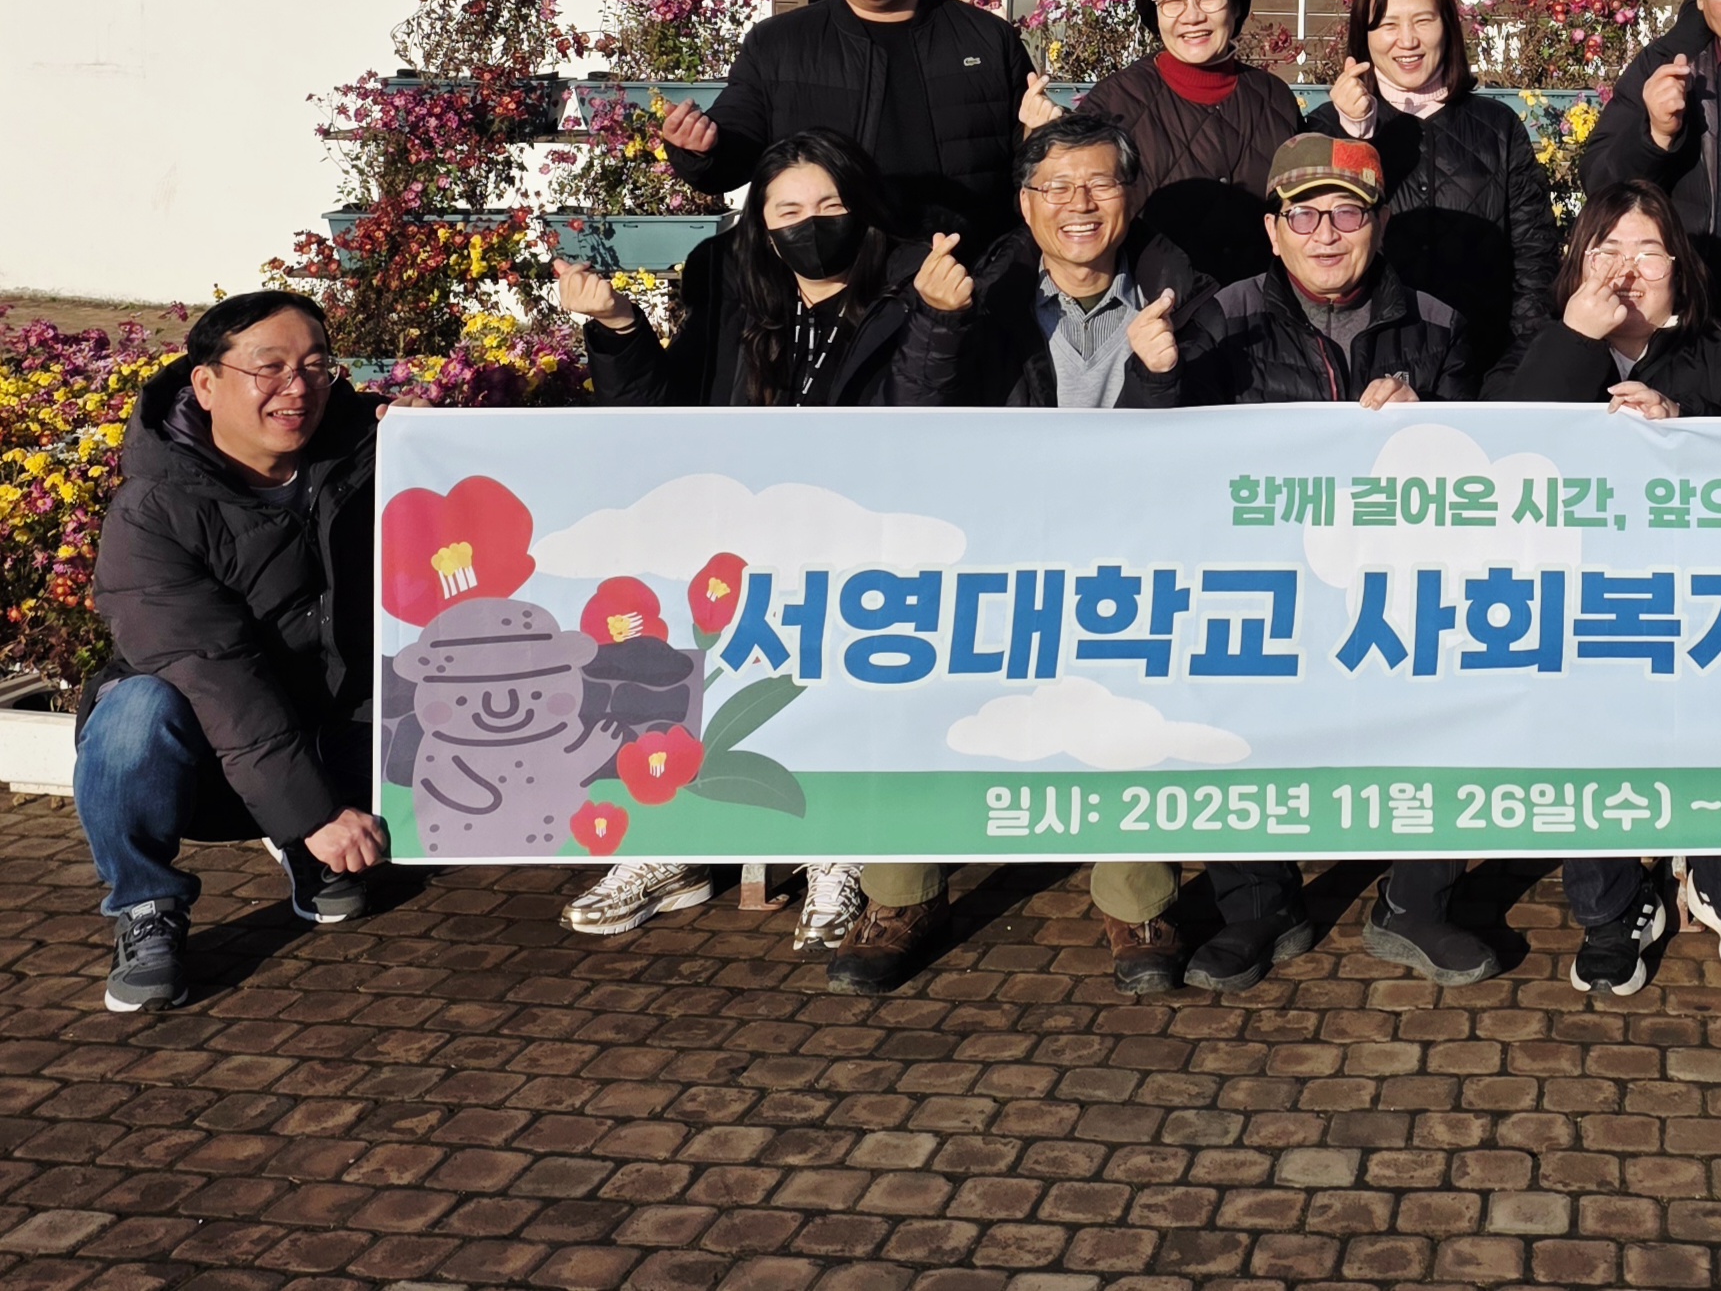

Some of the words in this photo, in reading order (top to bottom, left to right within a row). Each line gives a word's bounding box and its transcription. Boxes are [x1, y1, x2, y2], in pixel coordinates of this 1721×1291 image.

[1229, 475, 1336, 527] 함께
[1350, 476, 1499, 528] 걸어온
[1511, 477, 1627, 532] 시간,
[721, 566, 1299, 684] 서영대학교
[984, 784, 1102, 836] 일시:
[1119, 781, 1312, 835] 2025년
[1330, 782, 1436, 833] 11월
[1455, 780, 1673, 832] 26일(수)
